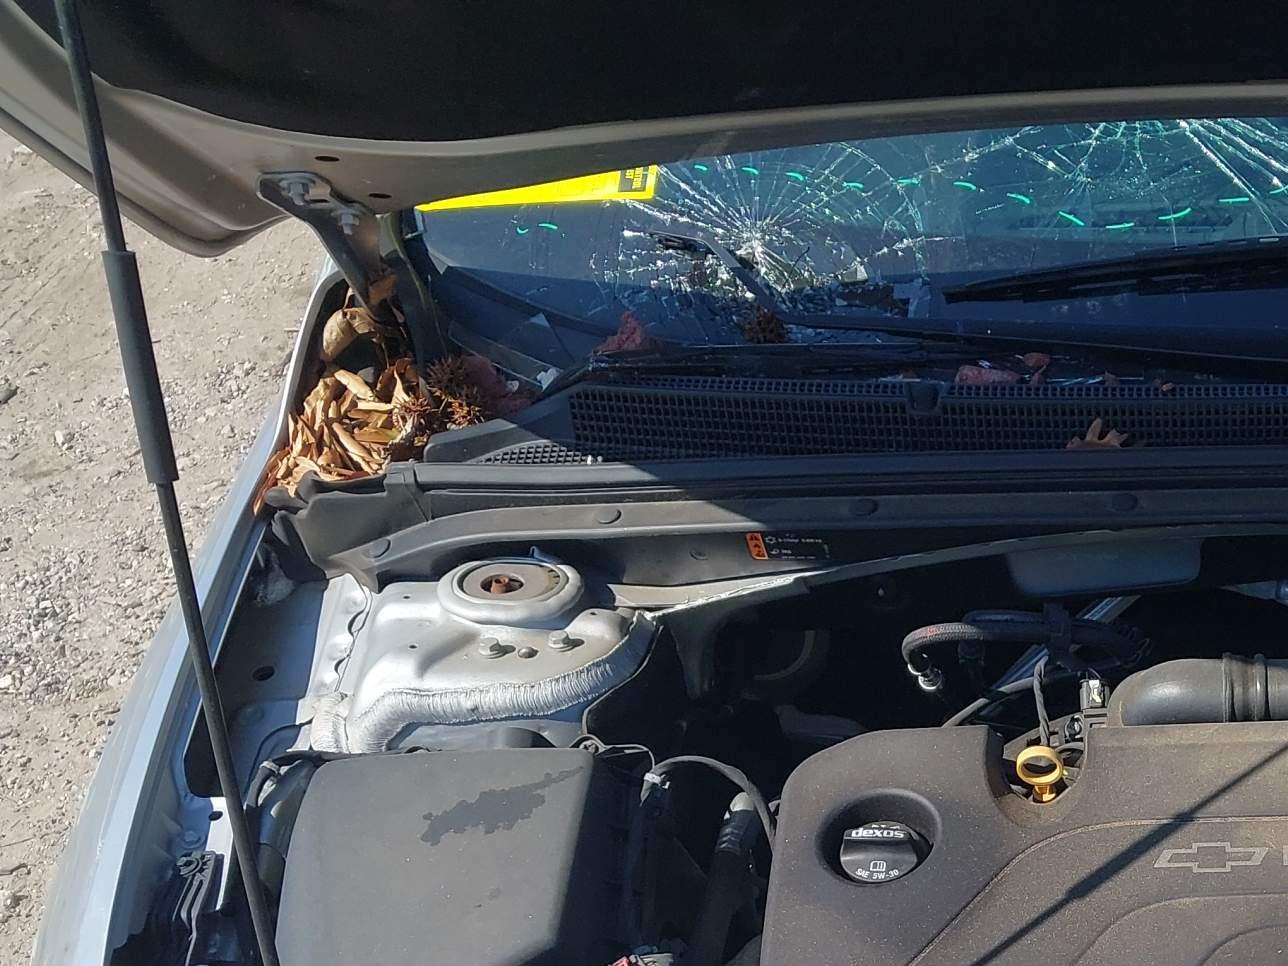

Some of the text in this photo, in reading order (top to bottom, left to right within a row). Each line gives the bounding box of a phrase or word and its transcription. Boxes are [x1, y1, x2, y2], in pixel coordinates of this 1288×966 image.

[851, 828, 905, 838] dexos
[855, 868, 899, 880] SAE 5W-30
